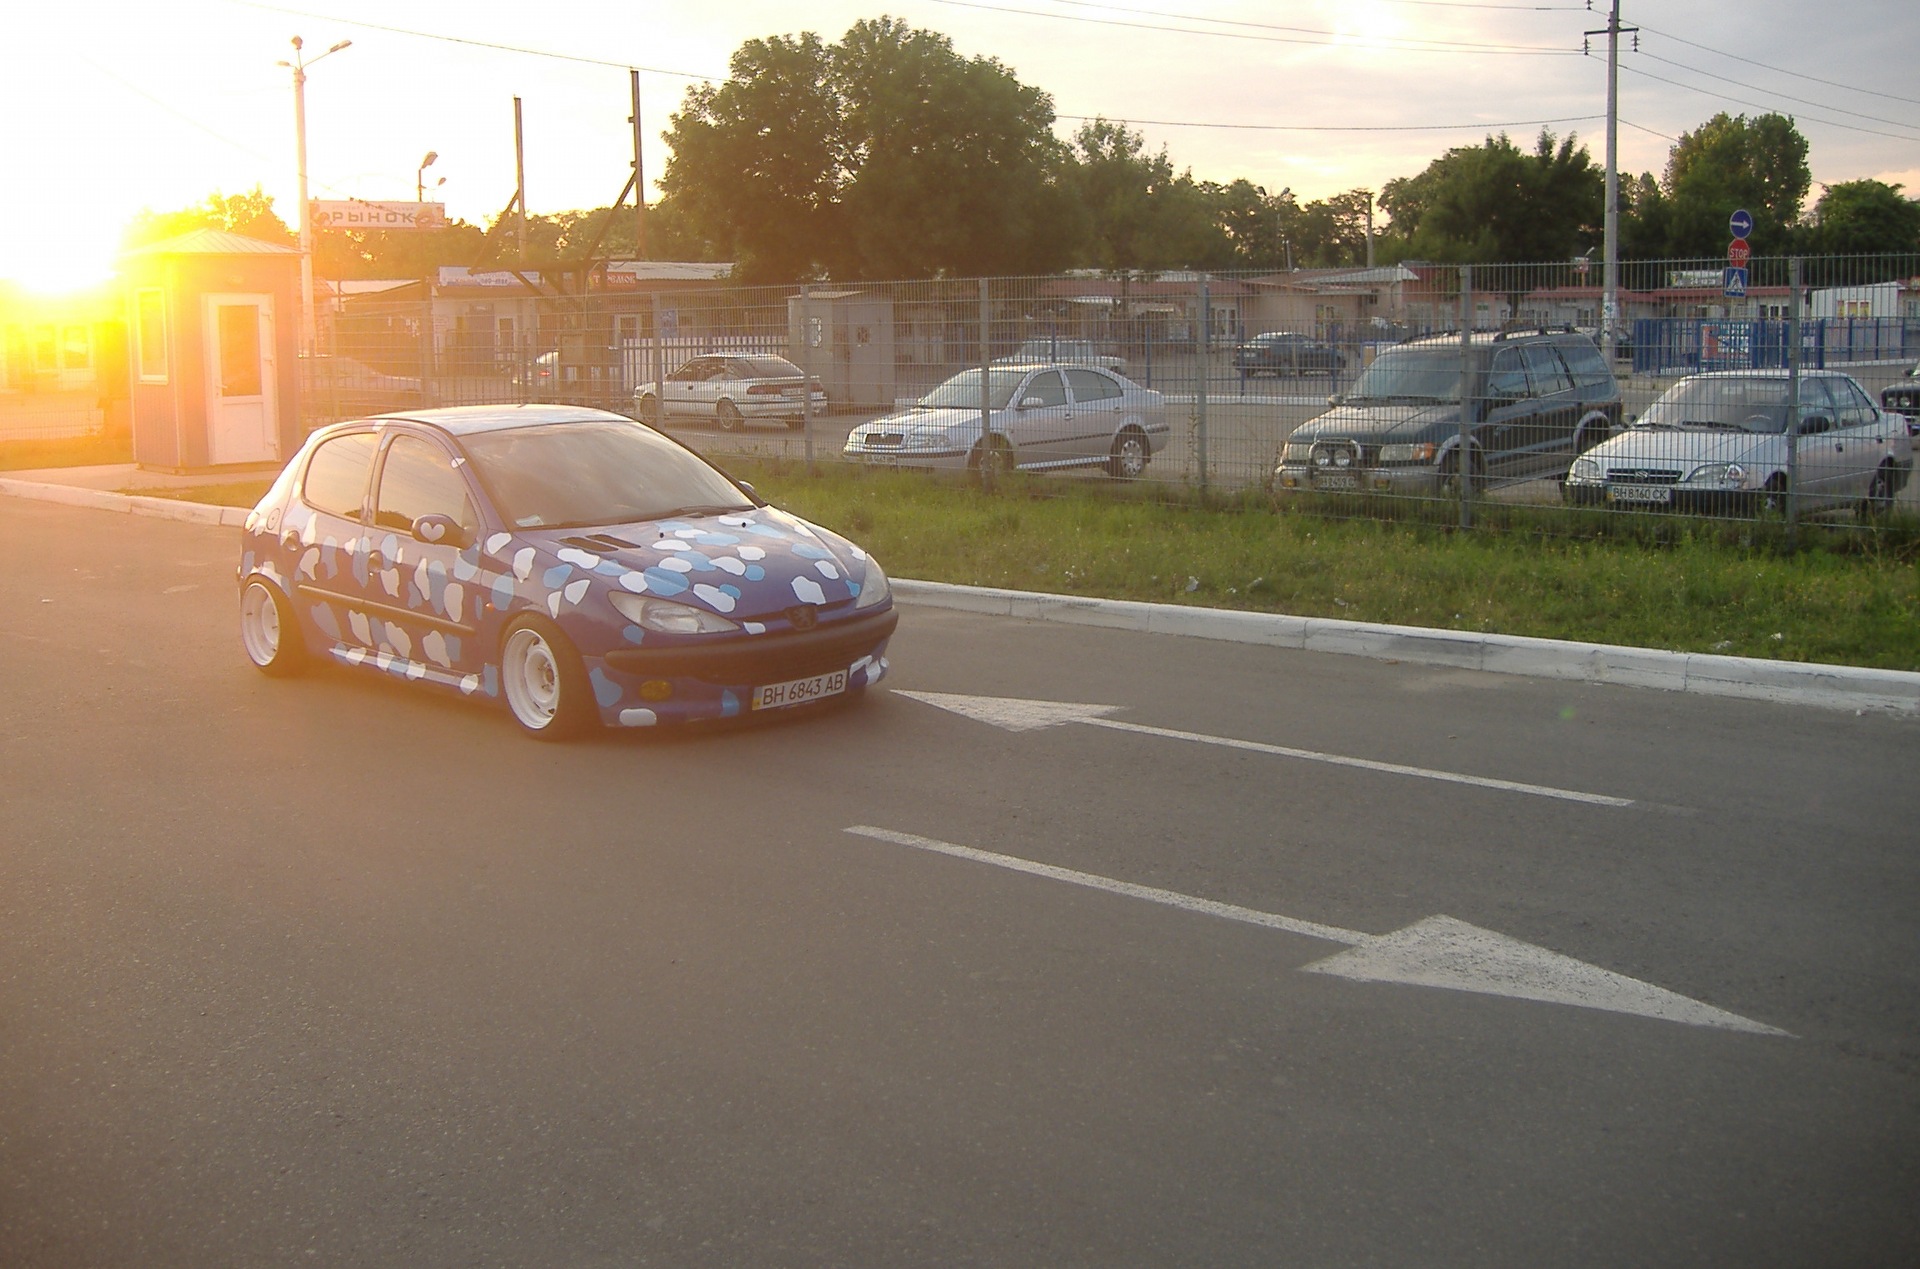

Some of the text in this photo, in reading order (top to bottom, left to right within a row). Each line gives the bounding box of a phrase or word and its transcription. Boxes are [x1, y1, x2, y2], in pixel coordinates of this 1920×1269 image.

[332, 211, 413, 223] РЫНОК
[1730, 248, 1748, 259] STOP
[1652, 489, 1667, 500] CK
[763, 673, 844, 705] BH 6843 AB
